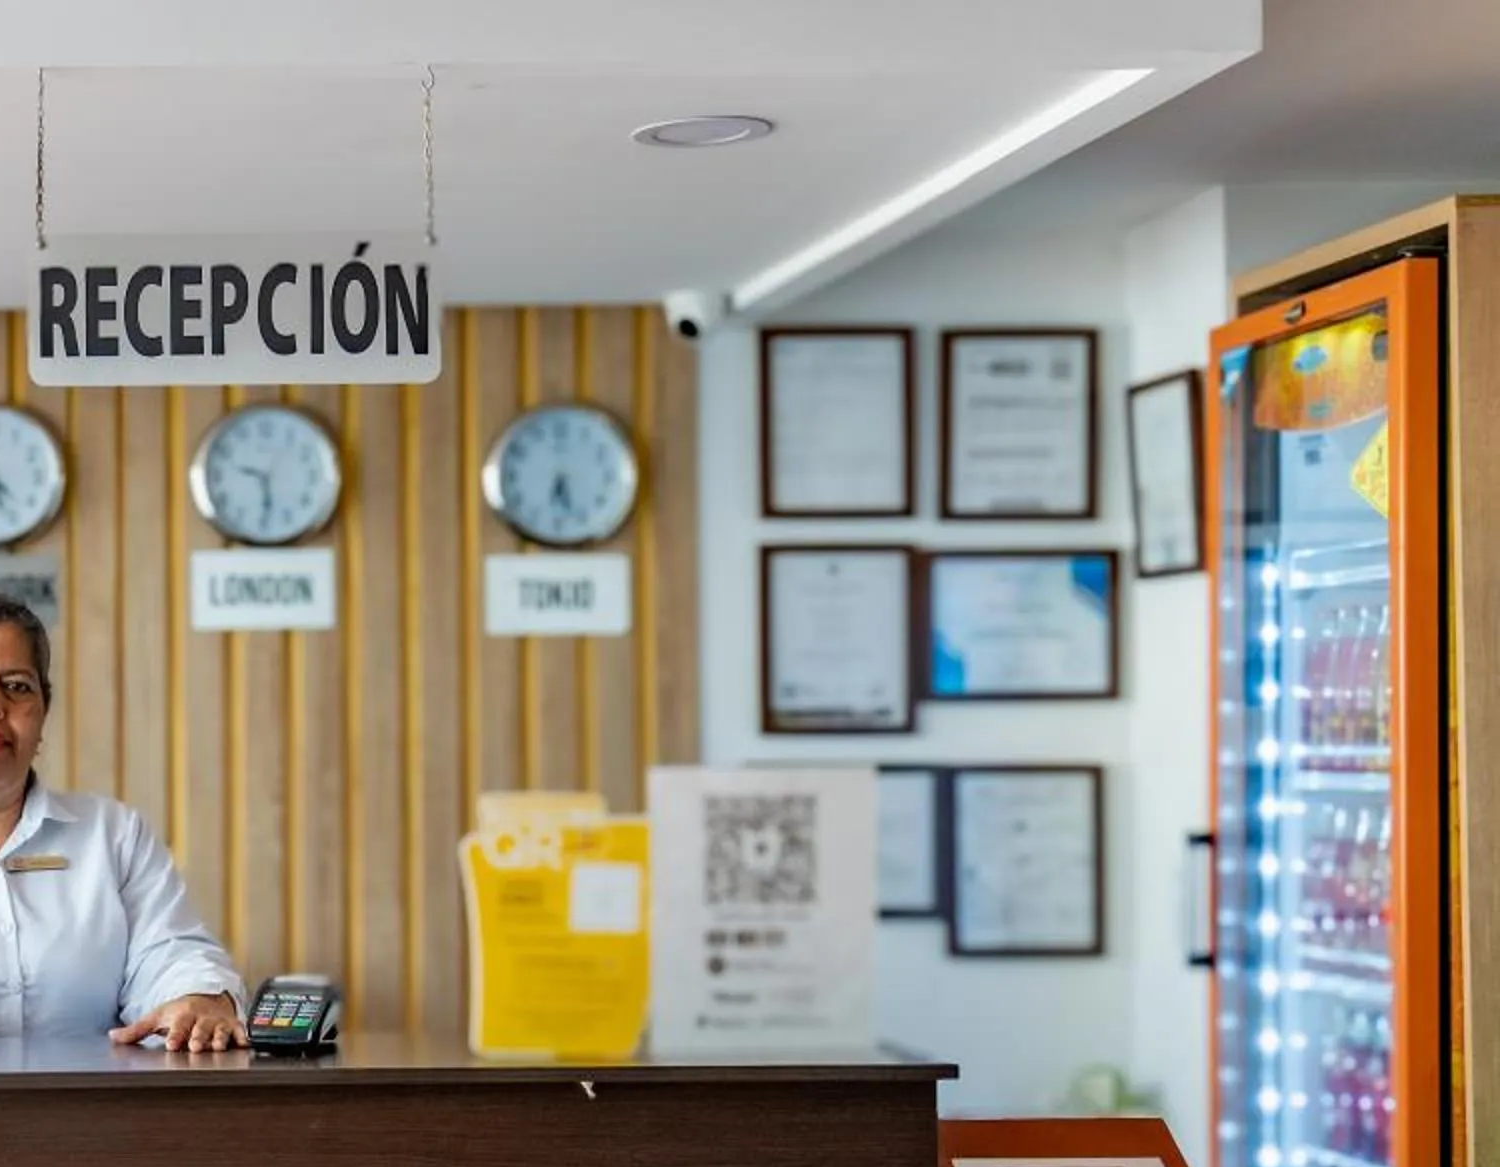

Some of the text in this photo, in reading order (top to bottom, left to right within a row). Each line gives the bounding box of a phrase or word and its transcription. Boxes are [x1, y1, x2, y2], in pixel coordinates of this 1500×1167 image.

[38, 240, 430, 358] RECEPCIÓN
[208, 574, 314, 607] LONDON
[519, 578, 595, 612] TOKIO
